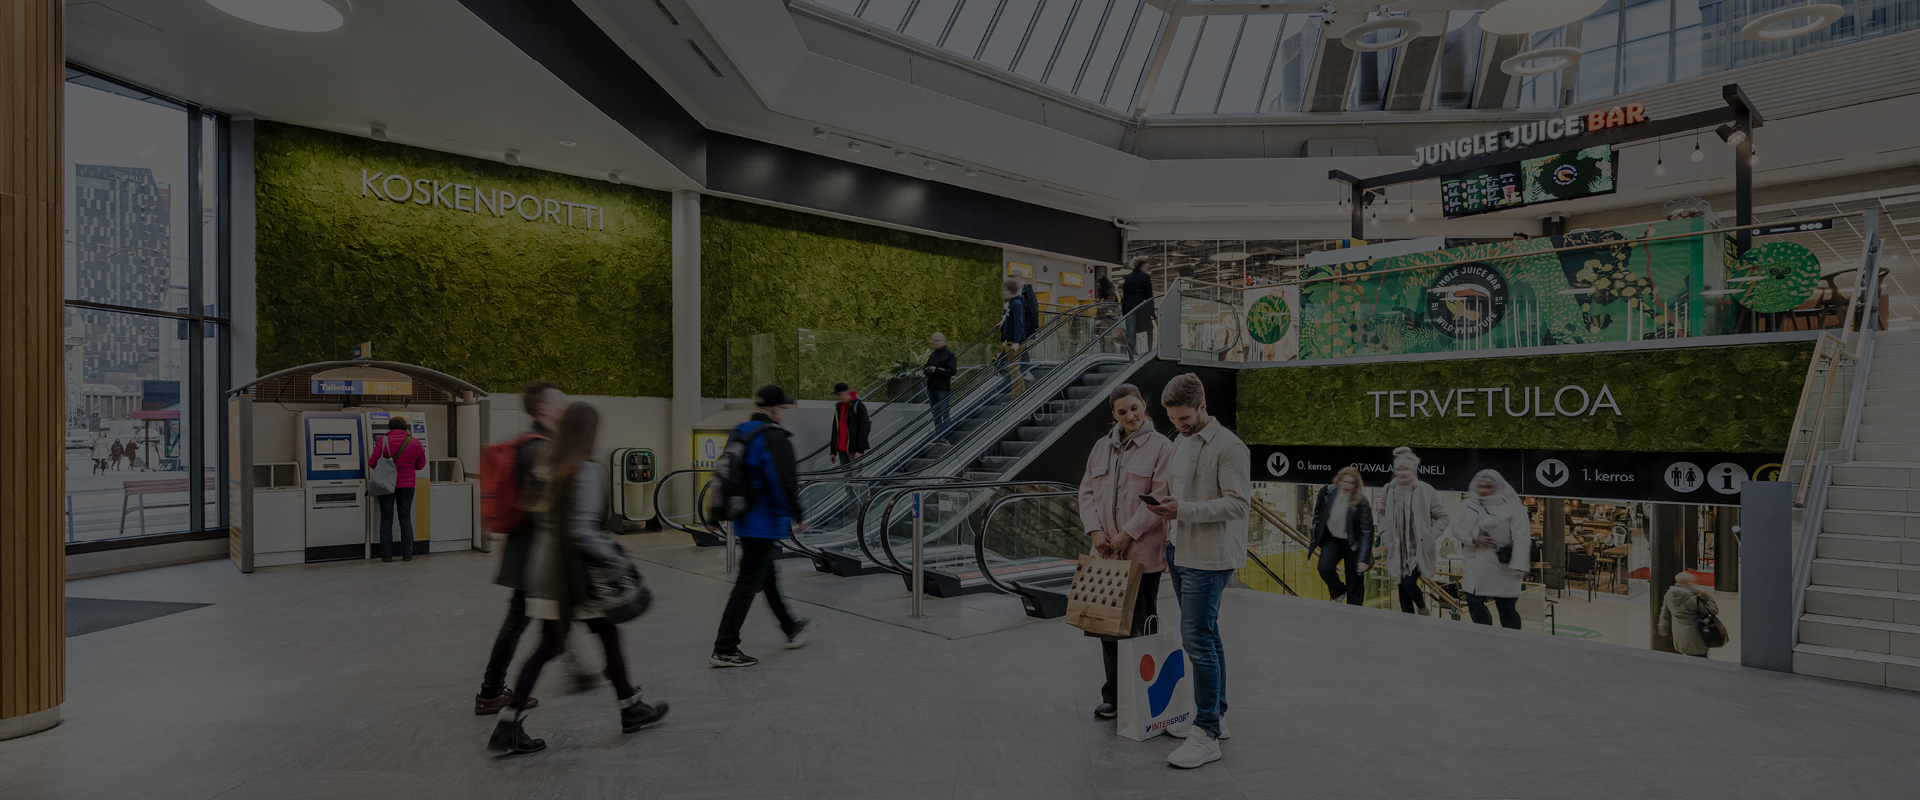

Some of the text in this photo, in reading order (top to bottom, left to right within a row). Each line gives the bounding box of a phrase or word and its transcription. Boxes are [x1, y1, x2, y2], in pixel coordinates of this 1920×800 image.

[1411, 101, 1645, 167] JUNGLE JUICE BAR
[362, 169, 604, 231] KOSKENPORTTI
[1461, 266, 1488, 277] JUICE
[1486, 274, 1501, 290] BAR
[1436, 316, 1454, 332] WILD
[1467, 312, 1498, 334] NATURE
[1366, 383, 1623, 418] TERVETULOA
[1307, 460, 1332, 471] kerros
[1582, 468, 1635, 482] 1. kerros
[1151, 712, 1190, 731] INTERSPORT
